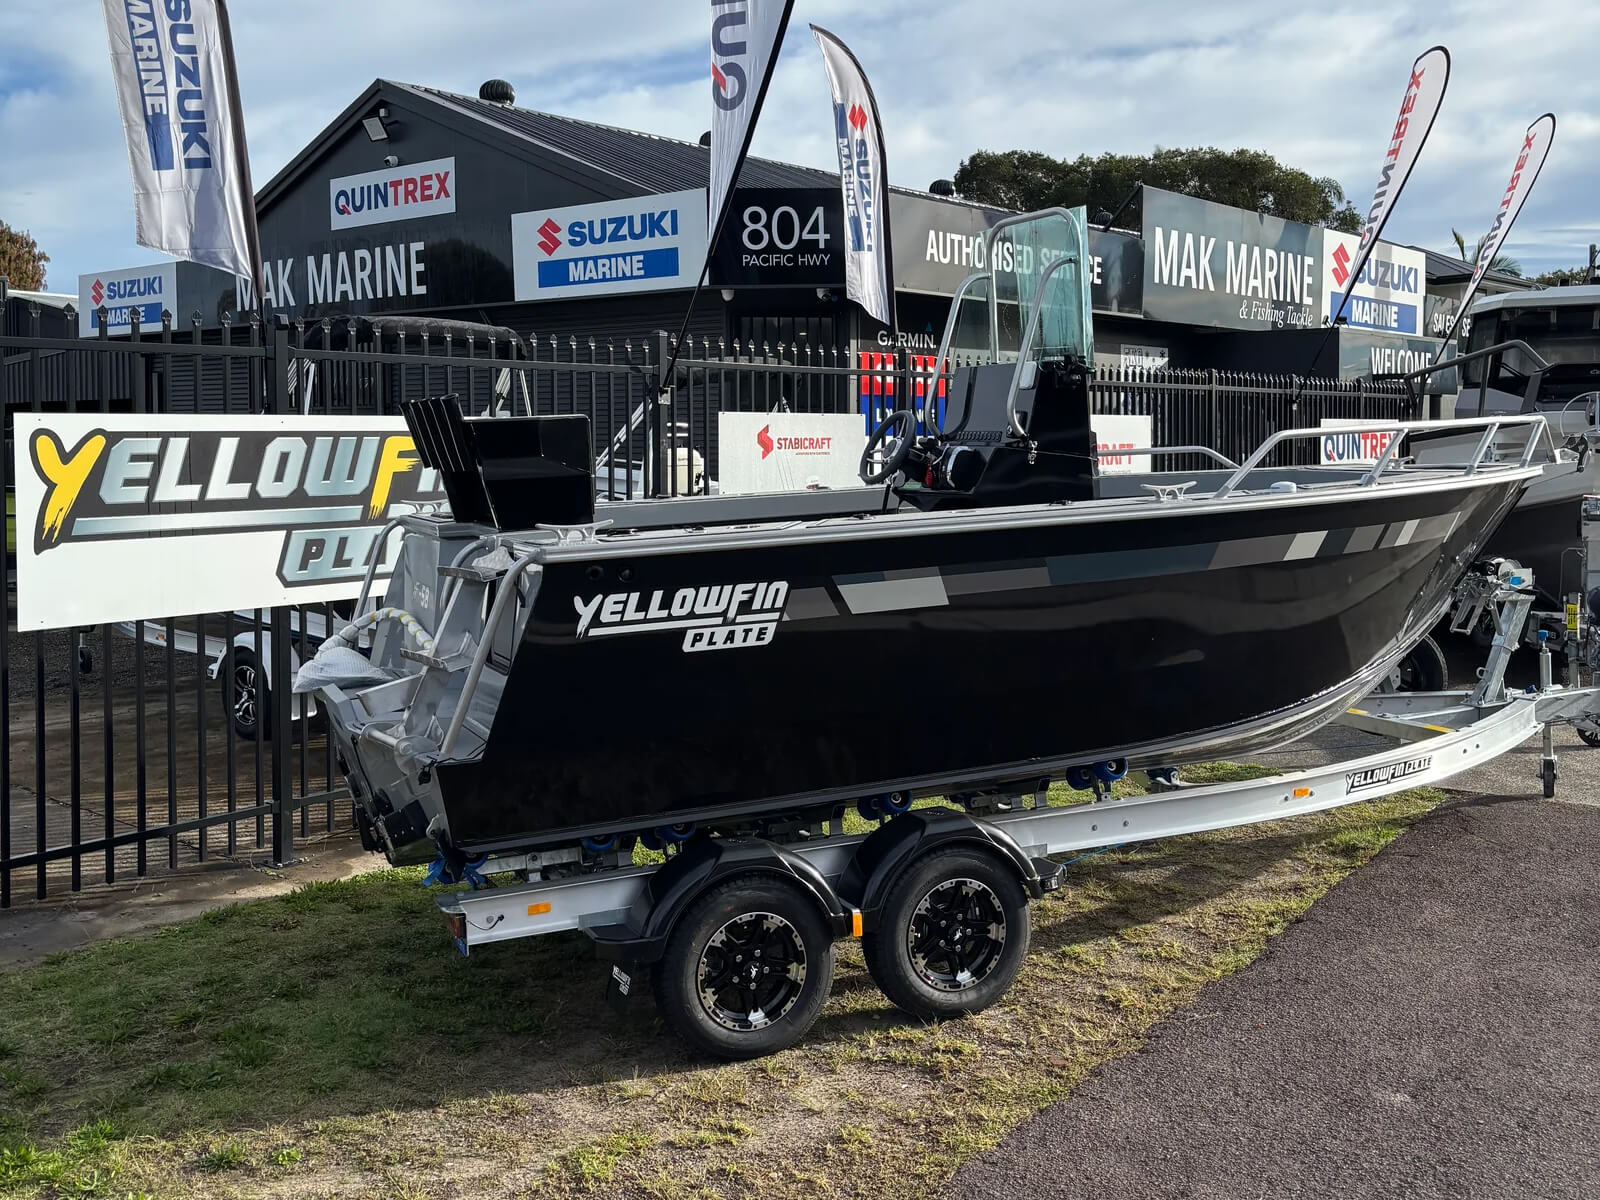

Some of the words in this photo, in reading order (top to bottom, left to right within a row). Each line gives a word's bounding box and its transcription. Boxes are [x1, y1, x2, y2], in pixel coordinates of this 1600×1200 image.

[164, 0, 212, 169] SUZUKI
[335, 171, 451, 216] QUINTREX
[855, 138, 873, 252] SUZUKI
[567, 209, 679, 247] SUZUKI
[742, 205, 831, 250] 804
[568, 254, 645, 282] MARINE
[742, 254, 794, 267] PACIFIC
[798, 254, 831, 266] HWY
[925, 229, 1034, 274] AUTHORISED
[1153, 226, 1217, 292] MAK
[1225, 240, 1315, 306] MARINE
[106, 276, 163, 300] SUZUKI
[307, 242, 428, 305] MARINE
[108, 306, 146, 325] MARIE
[1239, 300, 1249, 320] &
[1251, 301, 1284, 328] Fishing
[1286, 305, 1314, 328] Tackle
[1351, 299, 1399, 329] MARINE
[1371, 347, 1432, 384] WELCOME
[776, 437, 832, 450] STABICRAFT
[573, 580, 789, 639] YELLOWFIN
[689, 626, 769, 648] PLATE
[1345, 763, 1405, 795] YELLOWFIN
